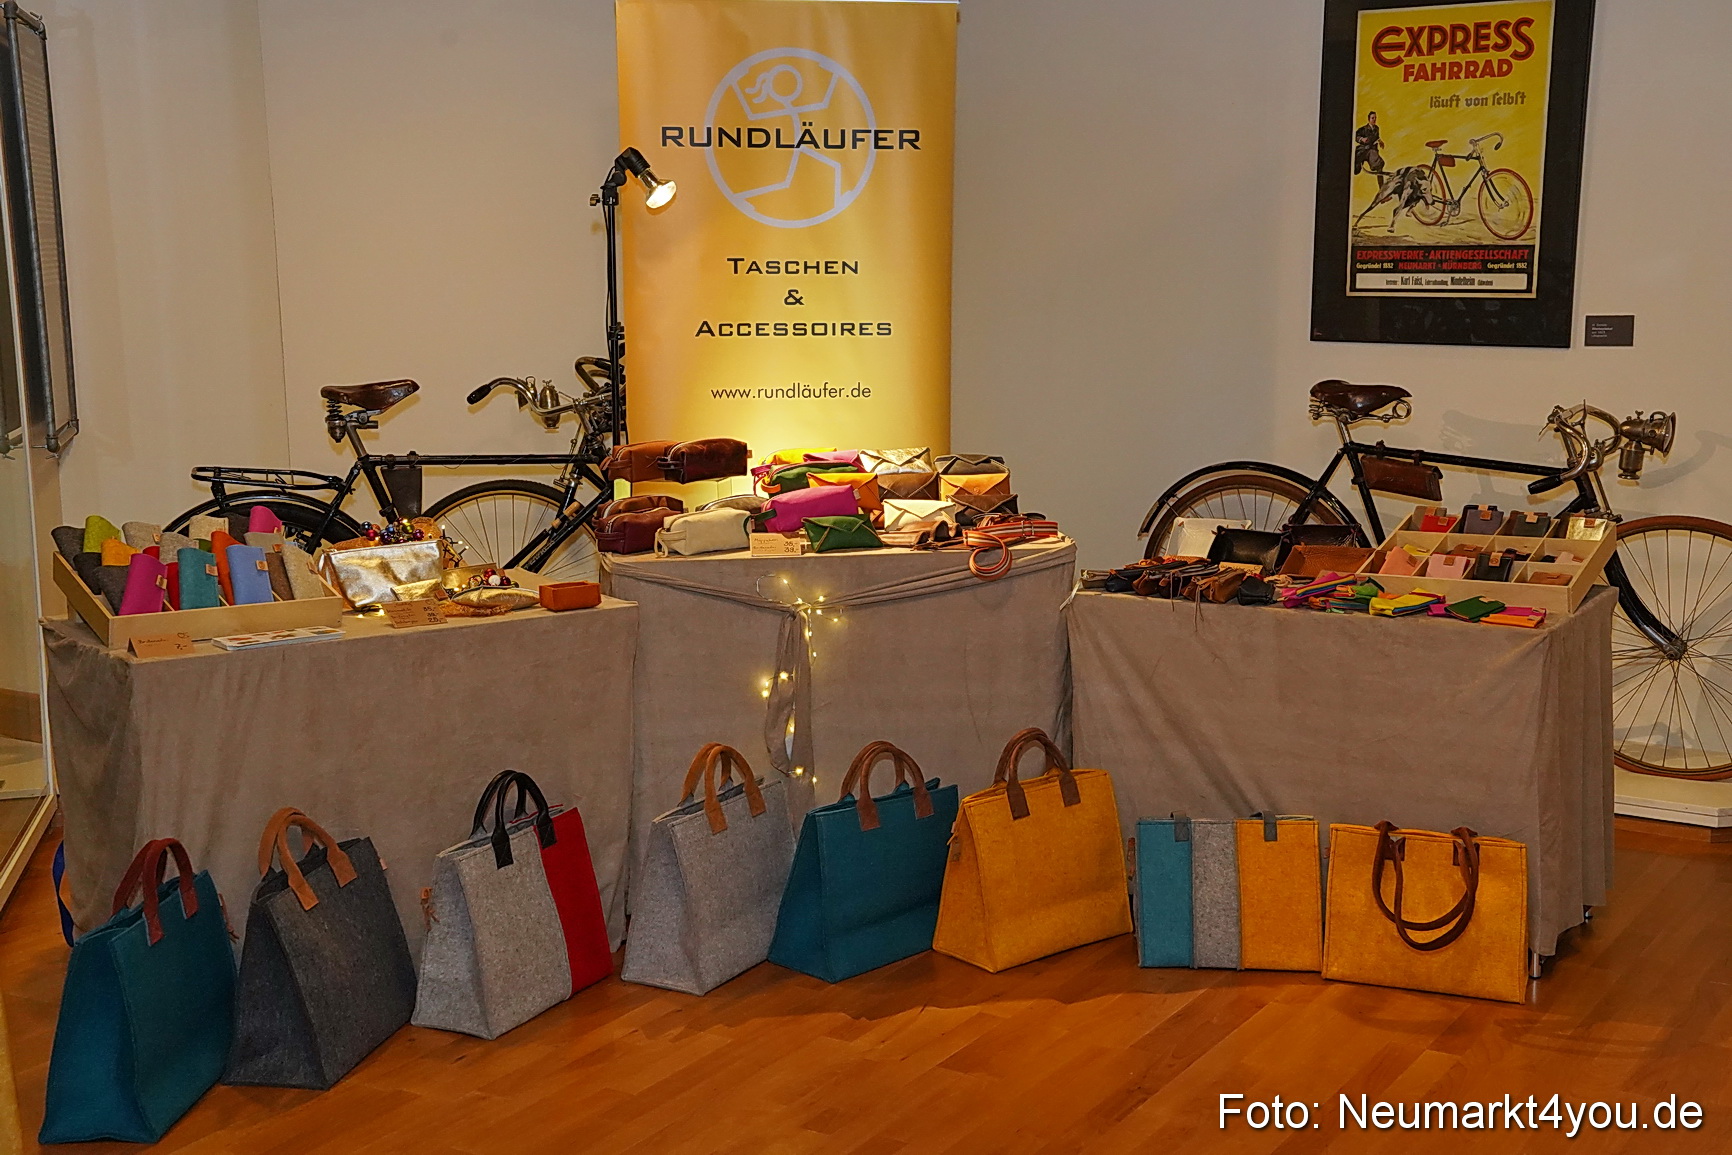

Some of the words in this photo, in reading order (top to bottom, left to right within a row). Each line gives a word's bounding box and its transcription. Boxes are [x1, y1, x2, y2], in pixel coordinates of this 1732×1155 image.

[1371, 17, 1535, 68] EXPRESS
[1403, 58, 1513, 82] FAHRRAD
[1430, 95, 1461, 109] läuft
[1465, 96, 1488, 107] von
[661, 121, 921, 150] RUNDLÄUFER
[1356, 250, 1424, 260] EXPRESSWERKE
[711, 382, 871, 399] www.rundläufer.de
